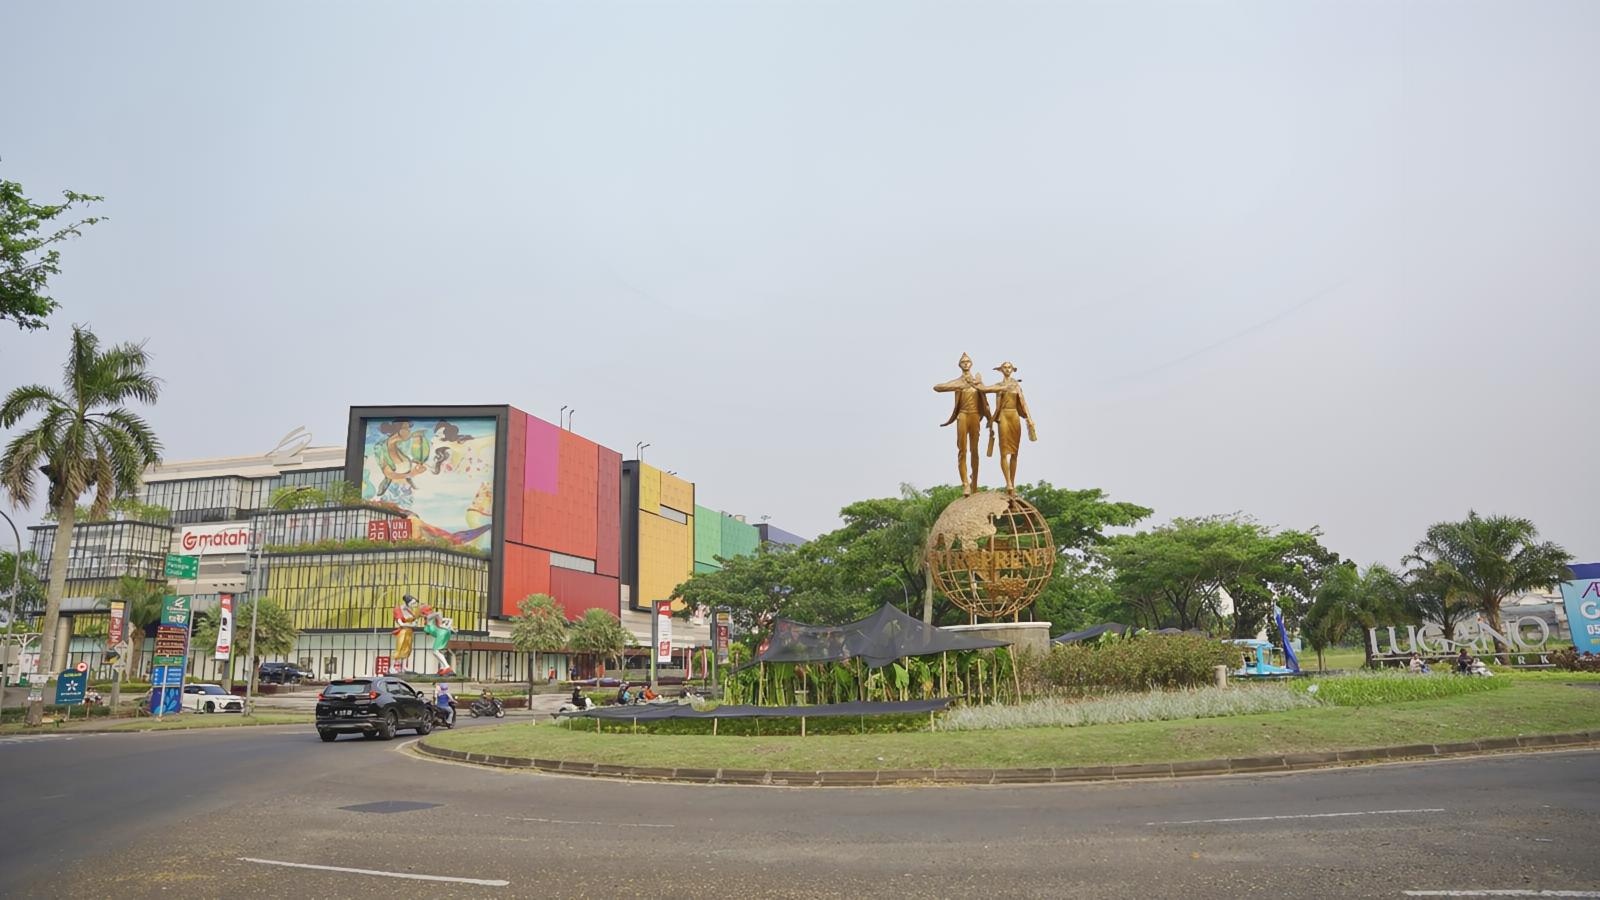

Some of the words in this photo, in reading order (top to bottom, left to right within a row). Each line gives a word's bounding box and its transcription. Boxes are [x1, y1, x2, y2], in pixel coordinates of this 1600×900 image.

[392, 521, 407, 530] UNI
[392, 530, 408, 540] QLO
[1369, 615, 1550, 656] LUGANO
